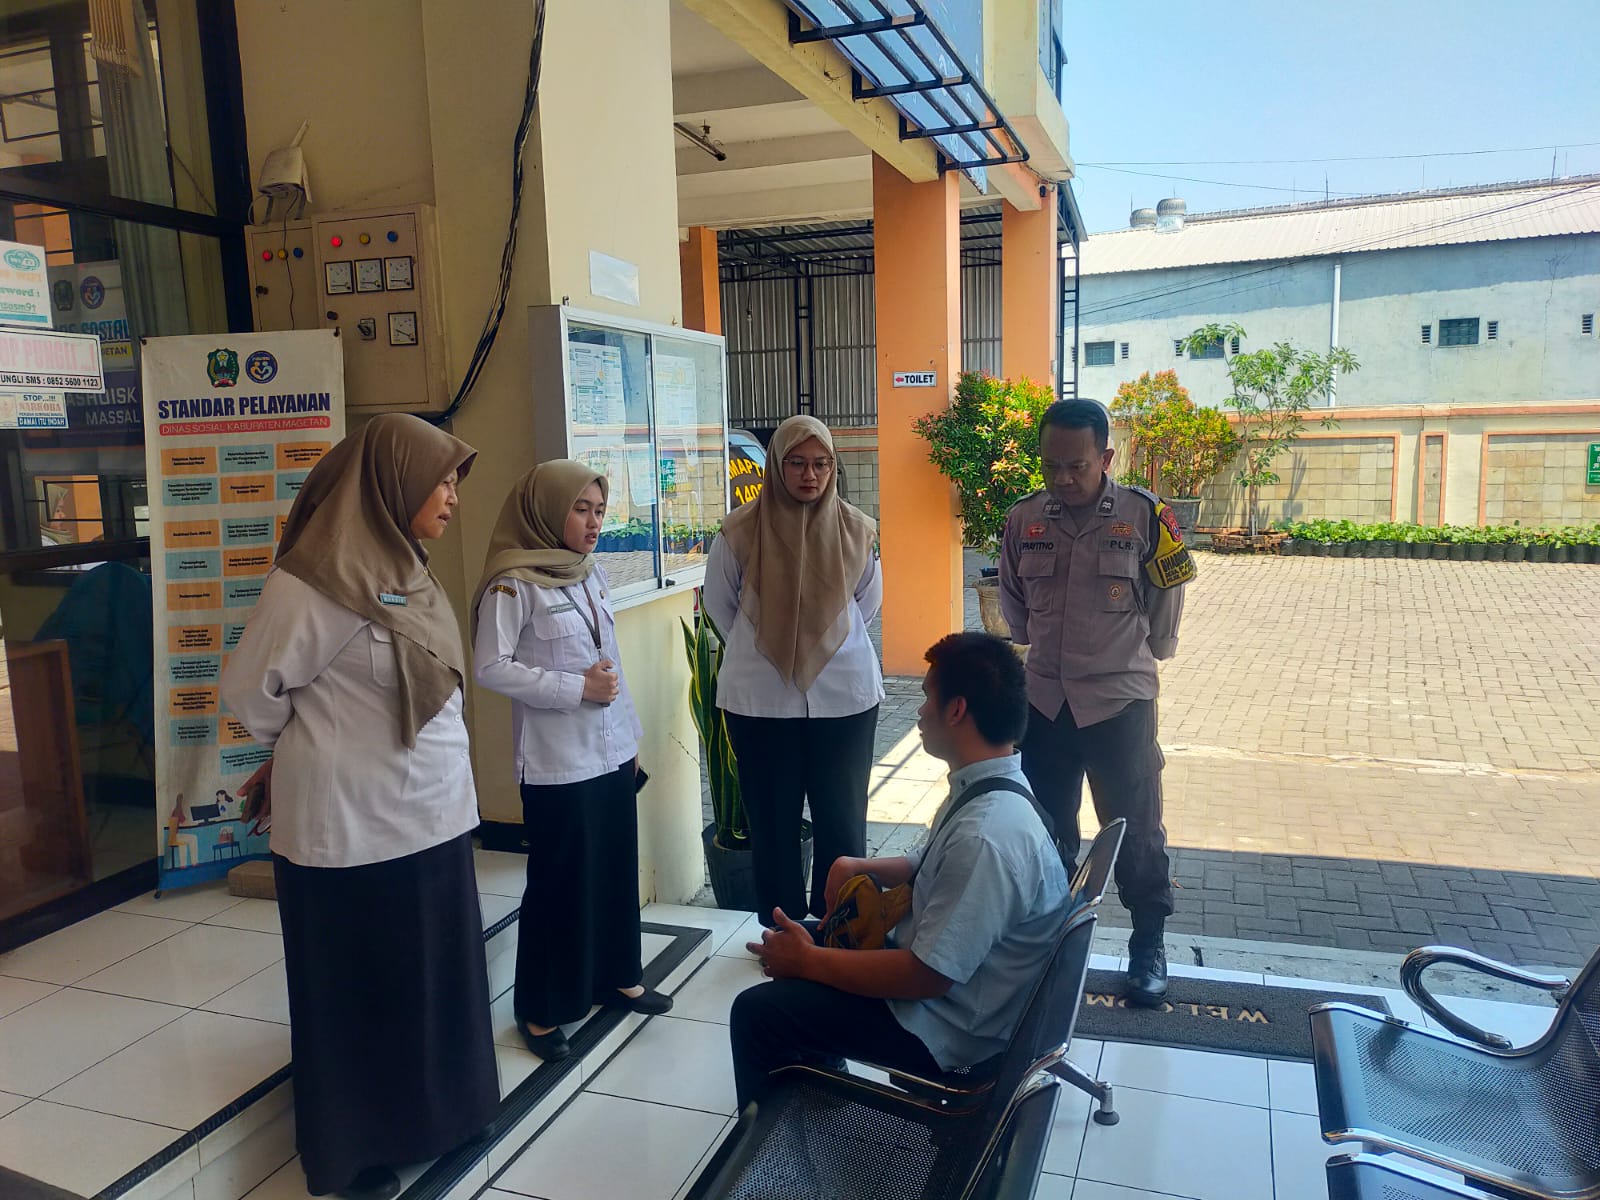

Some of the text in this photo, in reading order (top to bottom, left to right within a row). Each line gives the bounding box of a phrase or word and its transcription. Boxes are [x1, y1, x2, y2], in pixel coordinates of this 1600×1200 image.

[25, 376, 42, 385] SMS
[83, 378, 99, 387] 1123
[904, 374, 934, 384] TOILET
[158, 392, 331, 419] STANDAR PELAYANAN
[86, 408, 141, 425] MASSAL
[162, 418, 328, 435] DINAS SOSIAL KABUPATEN MAGETAN
